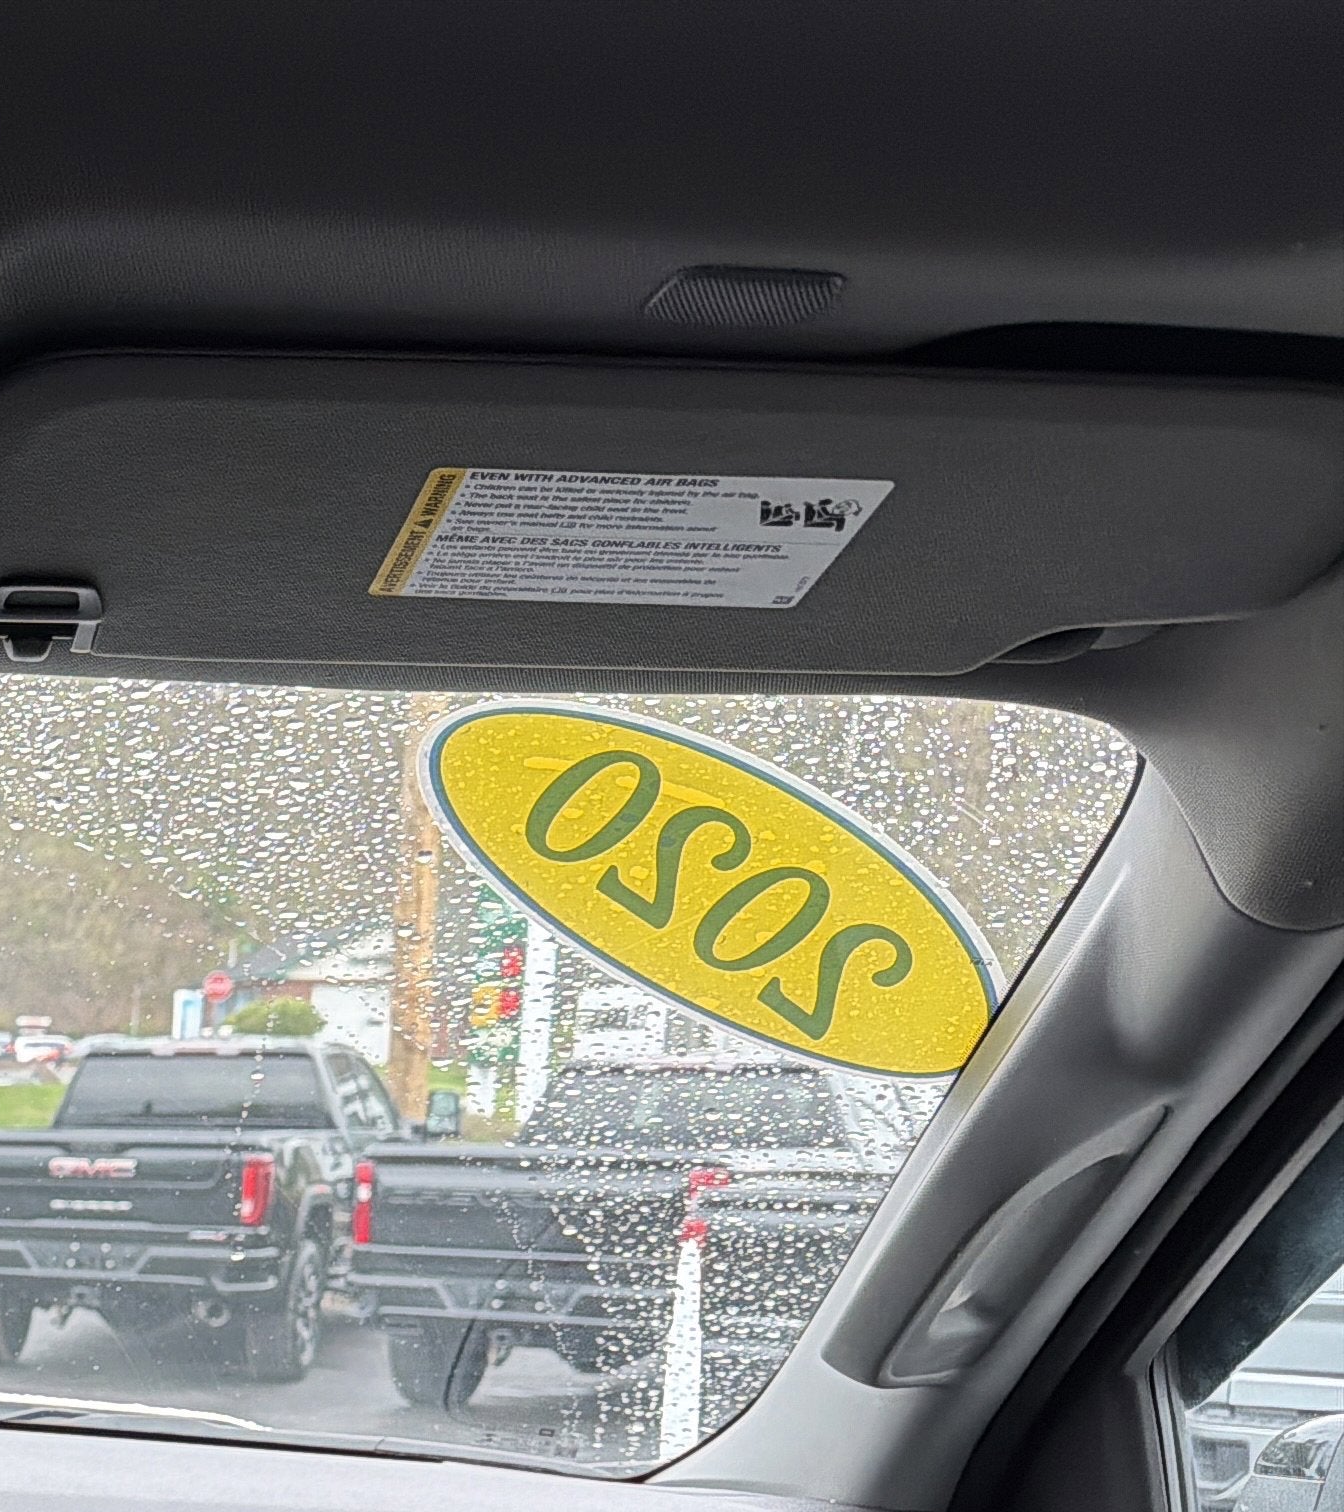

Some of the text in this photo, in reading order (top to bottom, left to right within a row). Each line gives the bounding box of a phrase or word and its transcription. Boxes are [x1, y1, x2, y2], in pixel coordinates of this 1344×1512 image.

[470, 471, 720, 487] EVEN WITH ADVANCED AIR BAGS
[421, 474, 457, 517] WARNING
[435, 533, 479, 543] MÊME
[480, 536, 518, 545] AVEC
[520, 537, 548, 545] DES
[550, 538, 588, 547] SACS
[591, 539, 682, 550] GONFLABLES
[684, 542, 783, 552] INTELLIGENTS
[379, 530, 427, 592] AVERTISSEMENT
[49, 1157, 138, 1178] GMC
